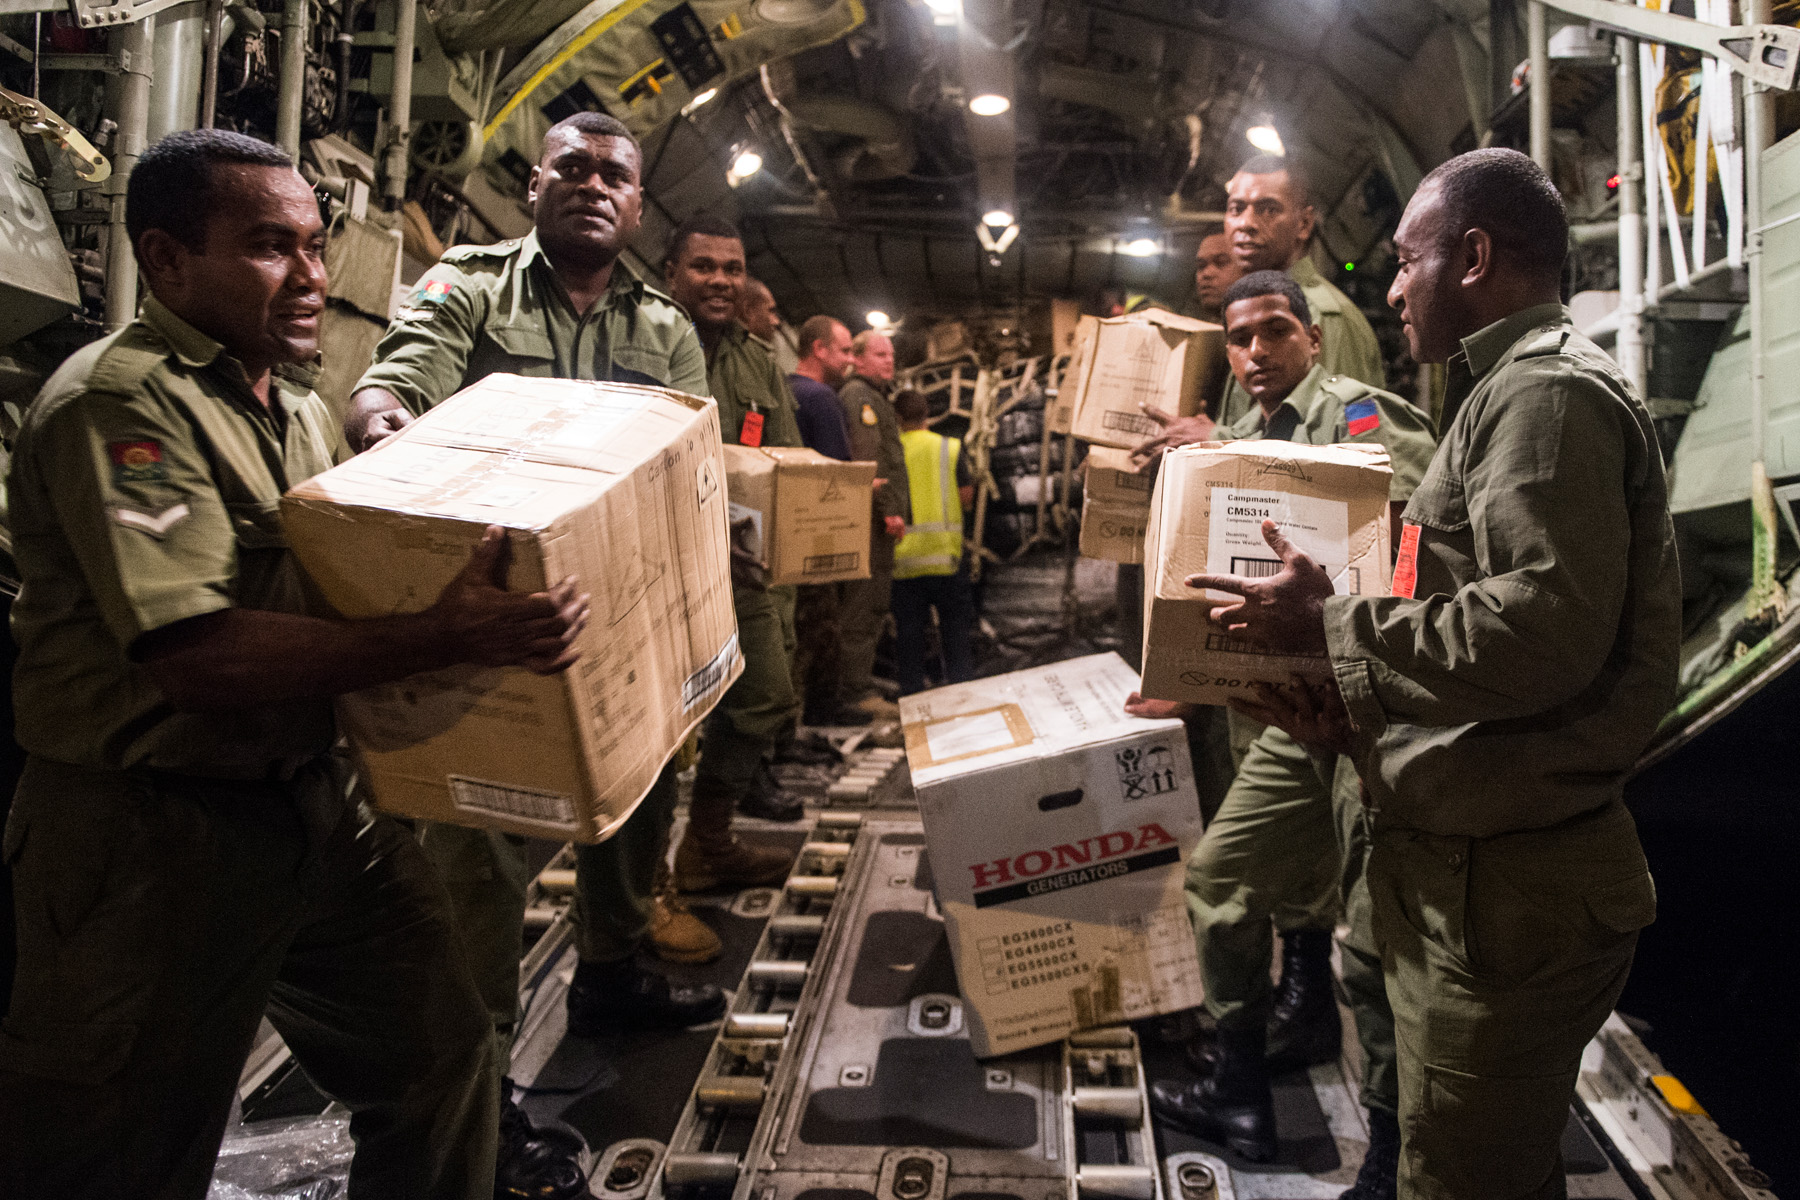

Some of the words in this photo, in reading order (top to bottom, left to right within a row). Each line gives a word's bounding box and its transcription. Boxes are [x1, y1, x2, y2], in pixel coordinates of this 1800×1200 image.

[1227, 494, 1280, 505] Campmaster
[1227, 506, 1270, 518] CM5314
[1213, 677, 1242, 688] DO
[969, 822, 1177, 889] HONDA
[1027, 860, 1129, 895] GENERATORS
[1005, 936, 1075, 961] EG4500CX
[1008, 951, 1077, 975] EG5500CX
